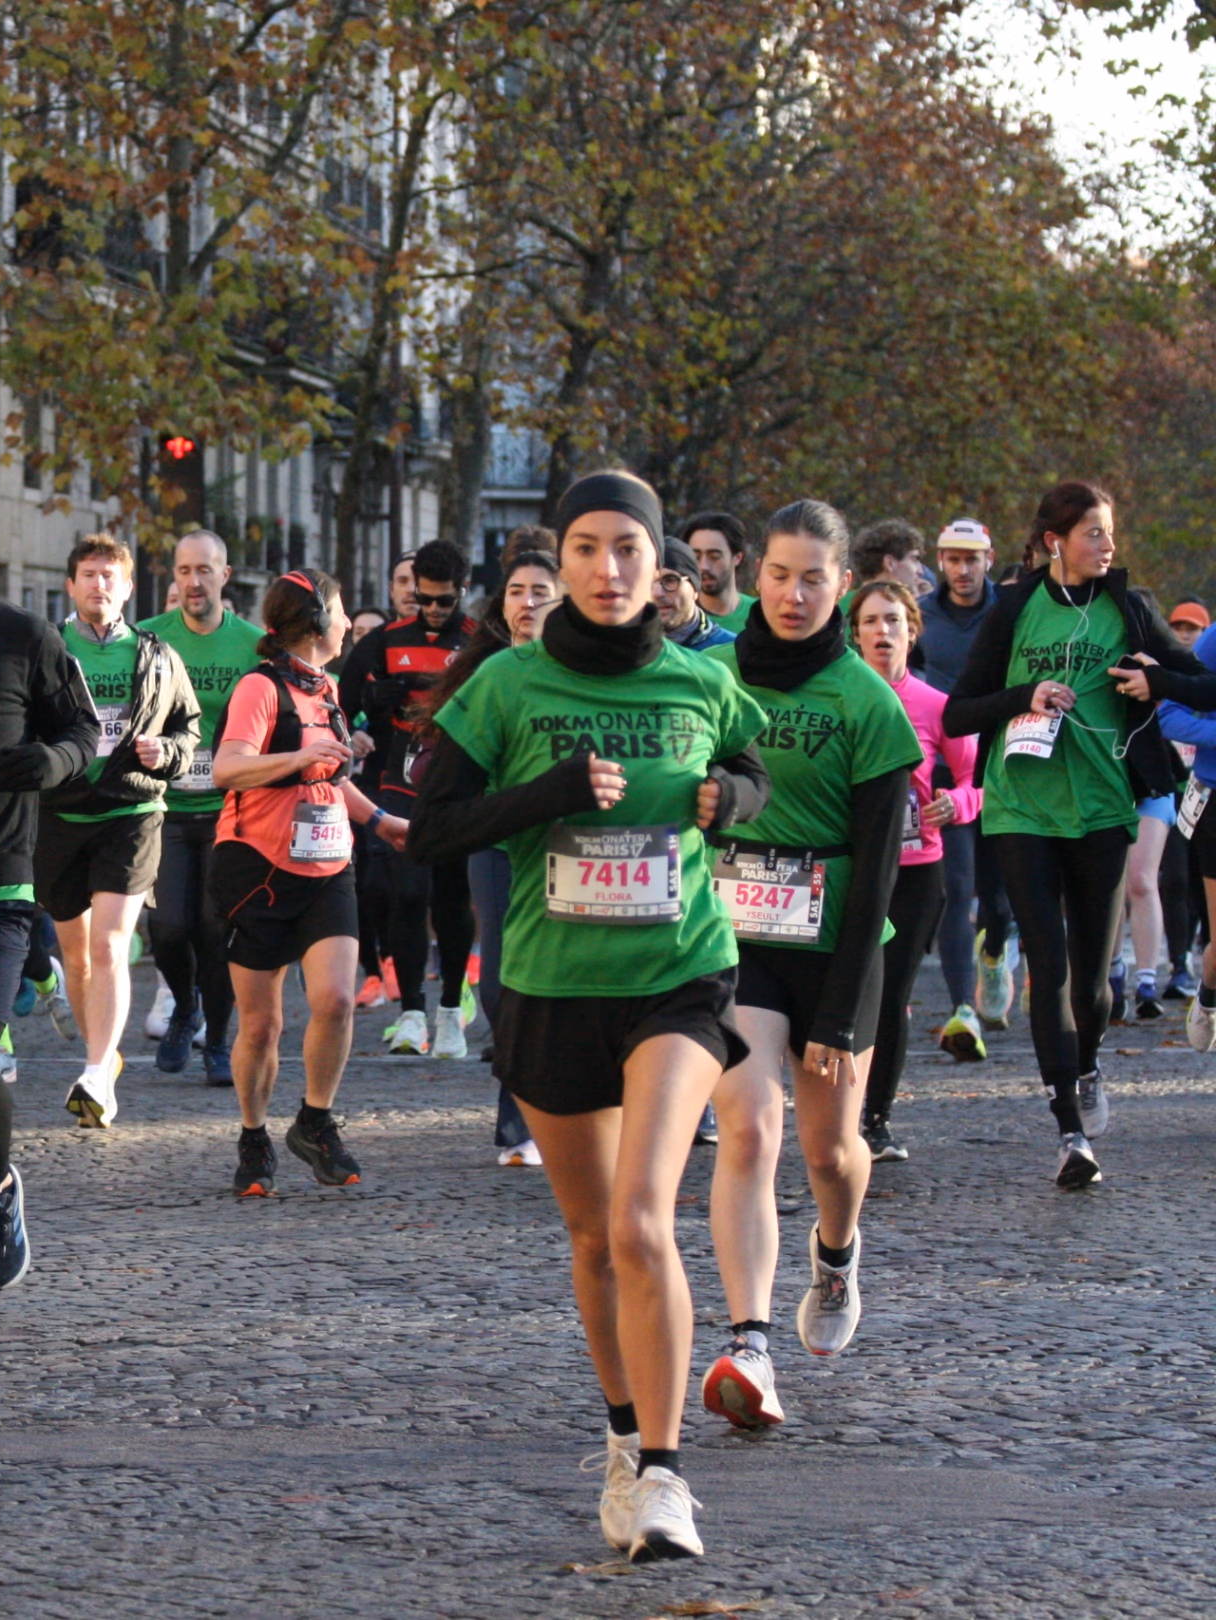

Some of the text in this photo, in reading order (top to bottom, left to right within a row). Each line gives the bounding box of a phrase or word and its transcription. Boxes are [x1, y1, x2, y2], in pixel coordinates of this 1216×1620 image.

[92, 683, 127, 699] RIS
[216, 678, 233, 694] 17
[529, 704, 705, 736] 10KM ONATERA
[766, 704, 846, 736] NATERA
[105, 722, 122, 736] 66
[551, 733, 696, 765] PARIS 17
[799, 729, 833, 760] 17
[311, 825, 343, 841] 5419
[602, 830, 653, 843] ONATERA
[582, 843, 646, 858] PARIS 17
[577, 861, 651, 888] 7414
[669, 869, 678, 892] SAS
[741, 869, 793, 885] PARIS 17
[595, 892, 633, 902] FLORA
[735, 883, 796, 910] 5247
[746, 911, 781, 921] YSEULT
[810, 900, 820, 919] SAS
